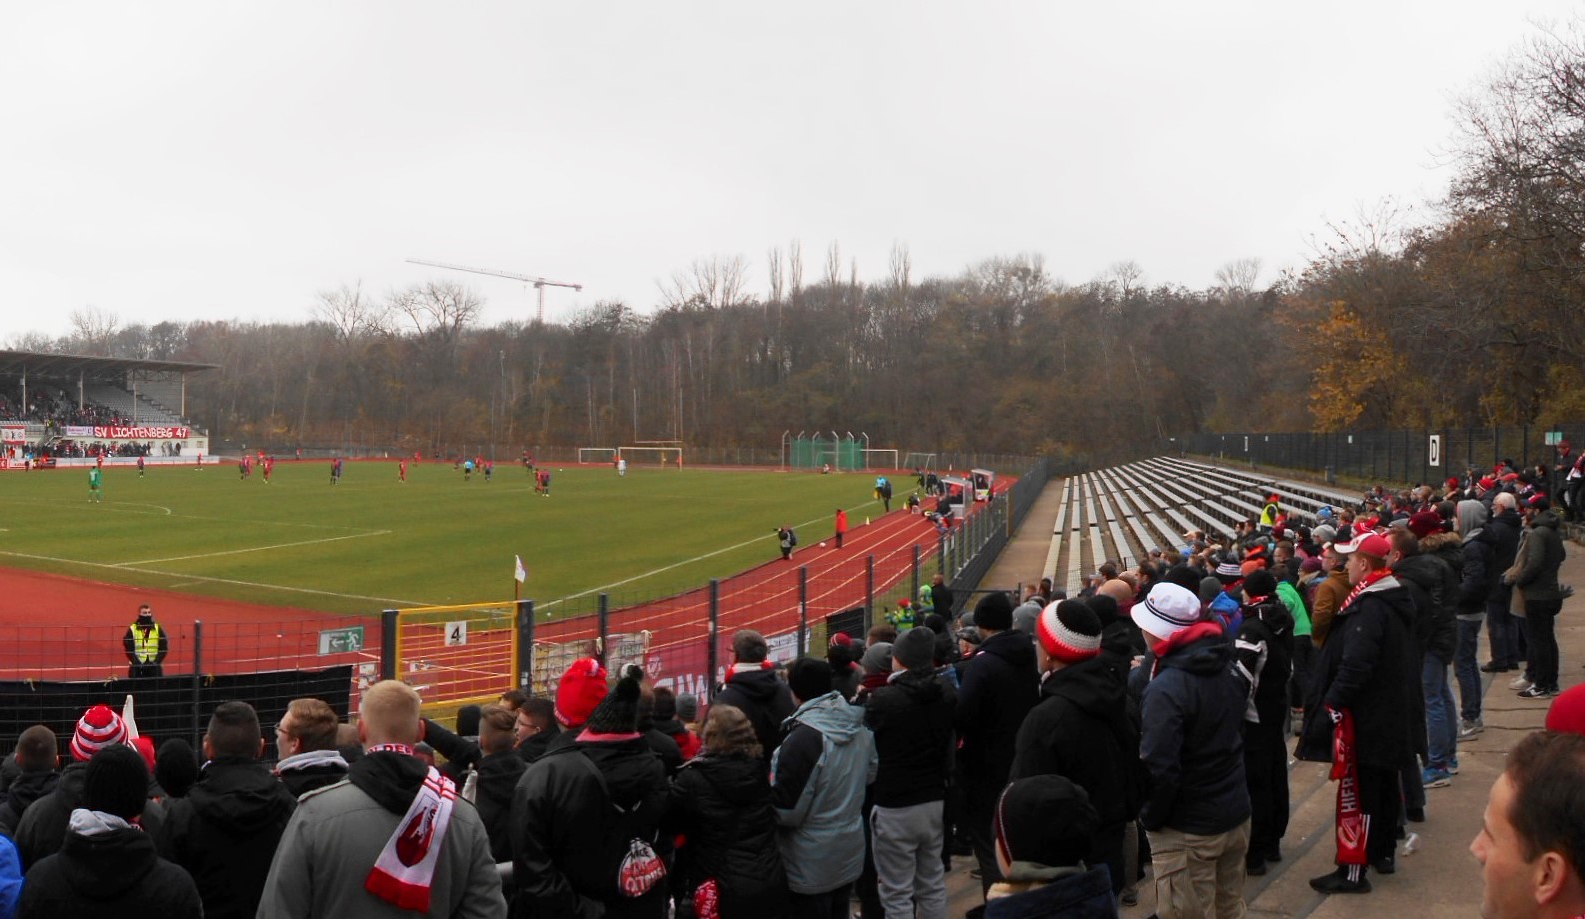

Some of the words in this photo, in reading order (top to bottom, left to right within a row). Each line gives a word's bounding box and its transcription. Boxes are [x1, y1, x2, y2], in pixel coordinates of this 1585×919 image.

[95, 426, 107, 438] SV
[111, 426, 173, 438] LICHTENBERG
[175, 427, 187, 438] 47
[1431, 439, 1438, 462] D
[451, 625, 461, 641] 4
